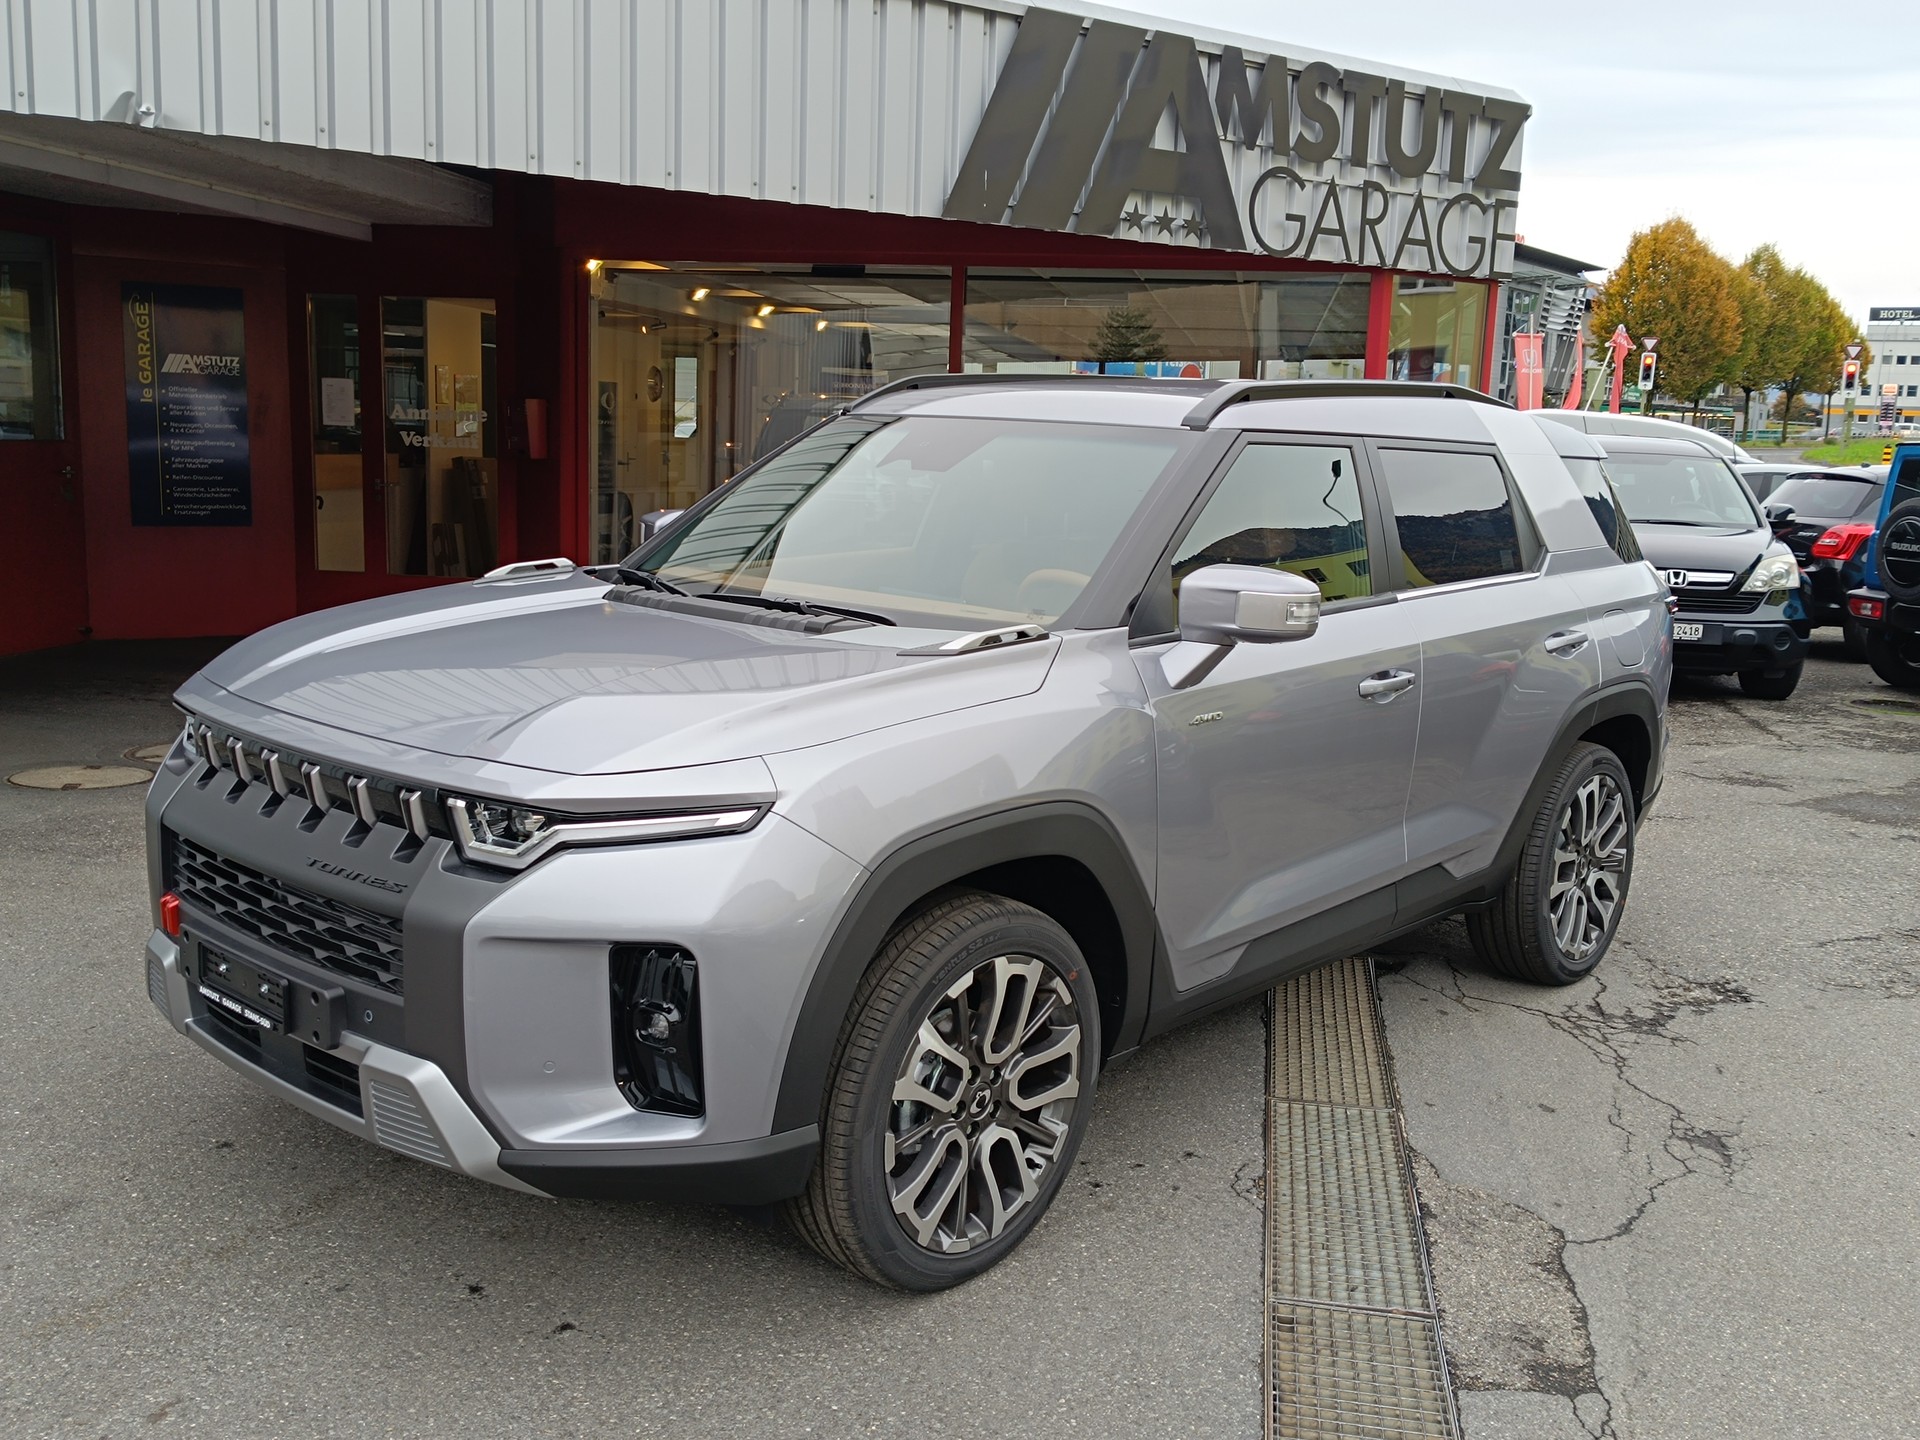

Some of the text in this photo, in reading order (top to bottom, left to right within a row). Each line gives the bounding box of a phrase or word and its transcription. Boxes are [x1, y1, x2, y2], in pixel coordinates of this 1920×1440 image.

[1249, 166, 1518, 280] GARAGE
[1879, 310, 1915, 318] HOTEL
[136, 302, 152, 403] le GARAGE
[198, 365, 240, 376] GARAGE
[399, 430, 480, 448] Verkauf
[1891, 542, 1920, 552] SUZUK
[1674, 626, 1700, 636] 2418
[306, 856, 408, 894] TORRES
[199, 986, 220, 1002] AMSTUTZ
[222, 998, 242, 1014] GARAGE
